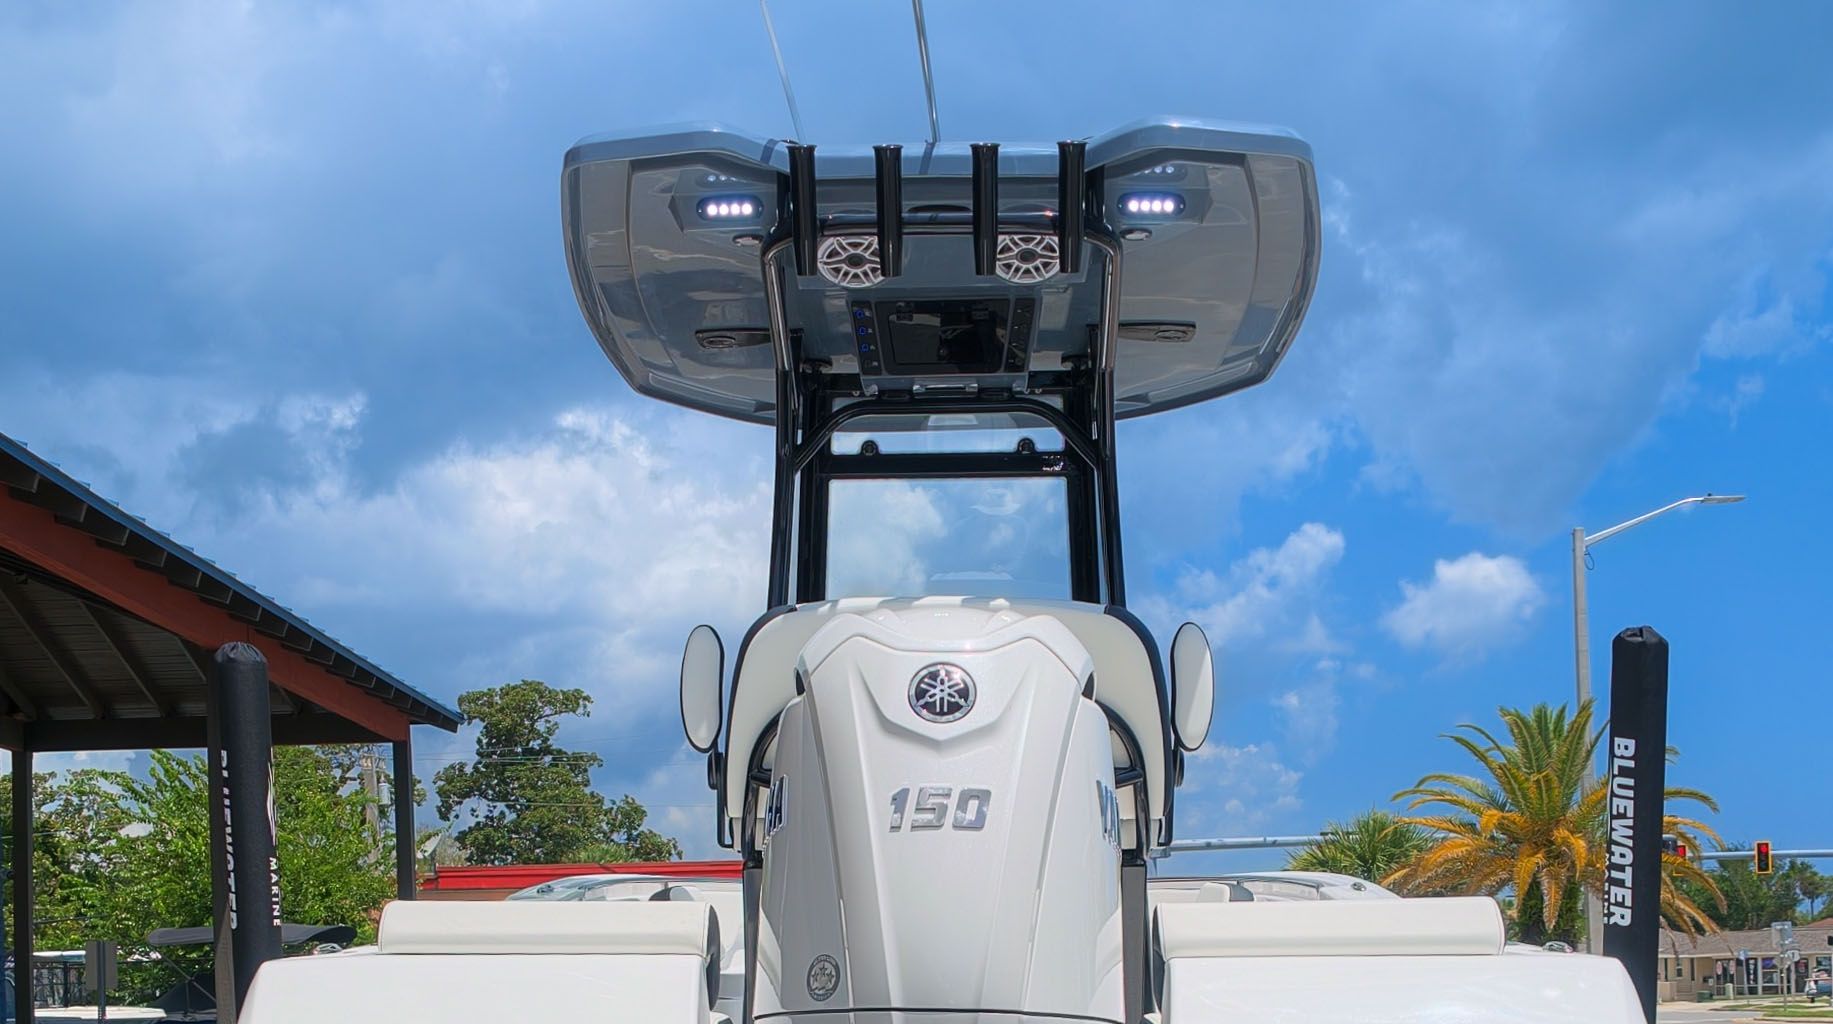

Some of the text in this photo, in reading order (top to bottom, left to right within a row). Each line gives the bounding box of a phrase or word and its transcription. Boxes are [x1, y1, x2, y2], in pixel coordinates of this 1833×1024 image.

[888, 787, 992, 833] 150
[1609, 737, 1635, 926] BLUEWATER
[269, 857, 281, 927] MARINE
